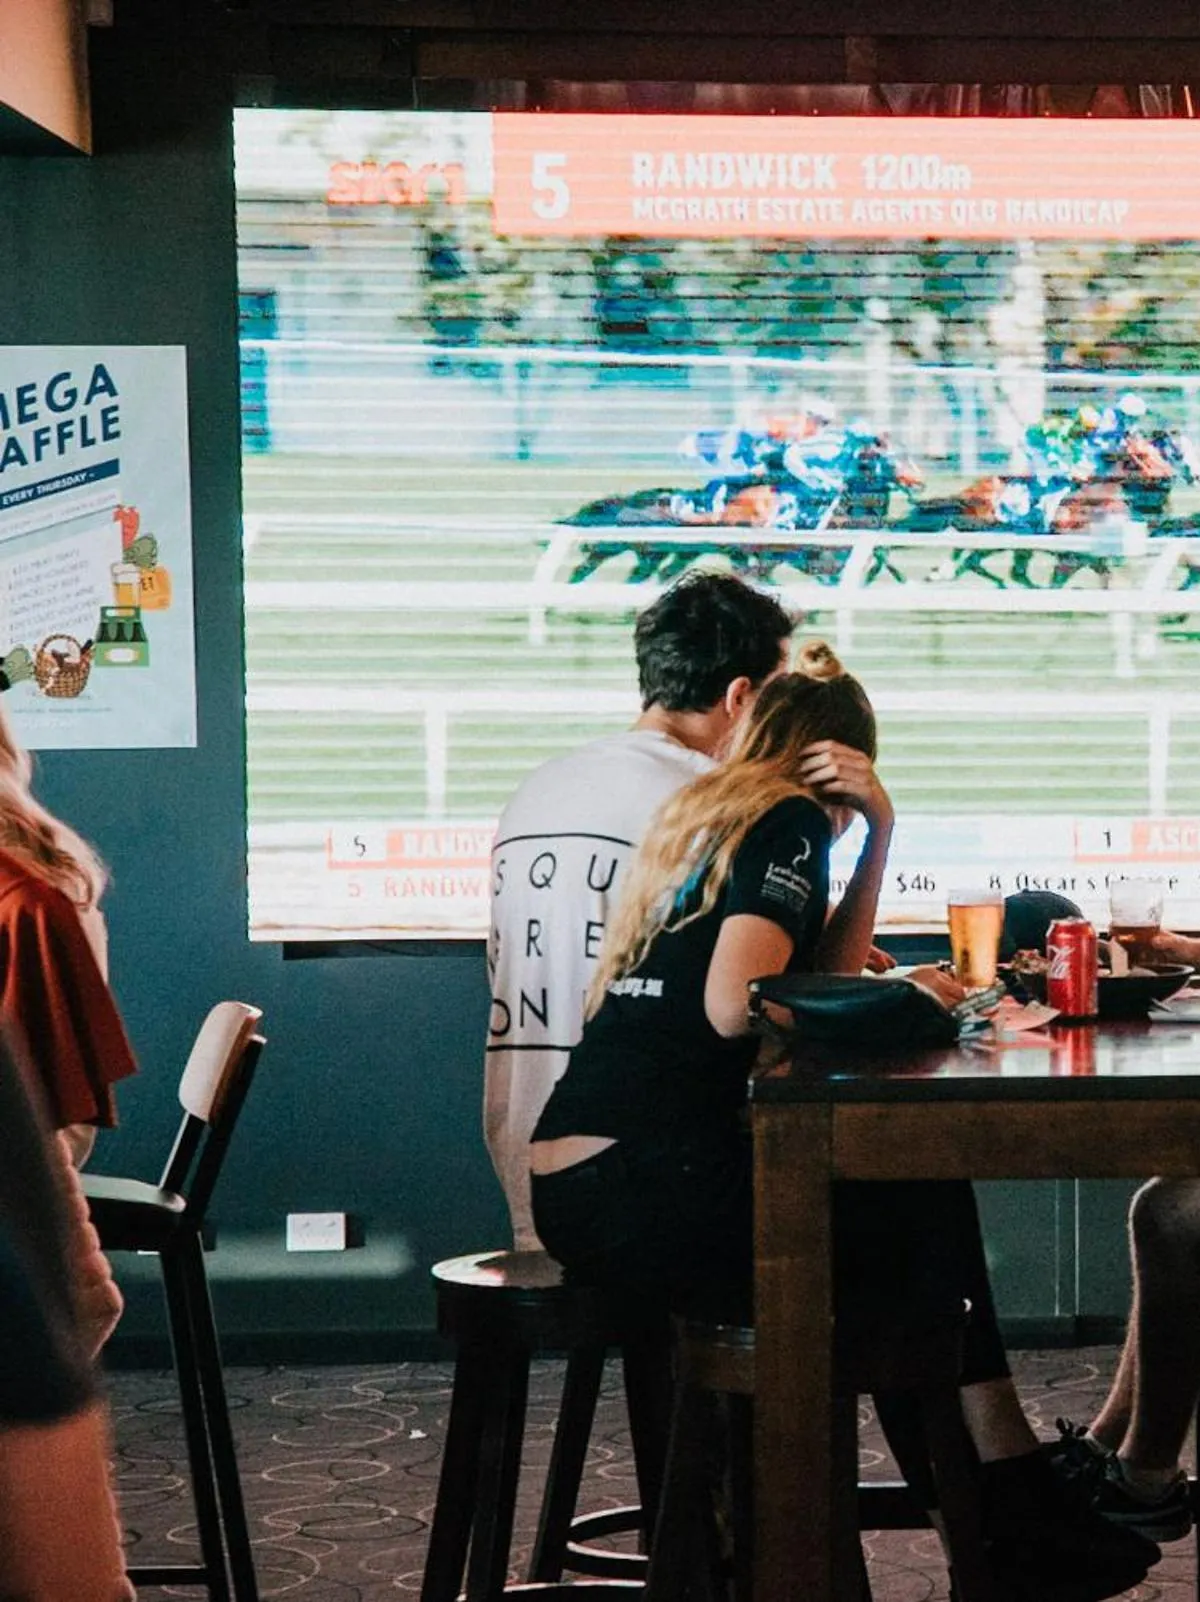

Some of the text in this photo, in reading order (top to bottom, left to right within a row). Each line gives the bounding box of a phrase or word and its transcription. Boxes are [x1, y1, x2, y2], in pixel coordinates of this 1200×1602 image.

[529, 153, 571, 220] 5
[632, 152, 972, 191] RANDWICK 1200m
[632, 197, 750, 222] MCGRATH
[757, 198, 844, 223] ESTATE
[852, 199, 943, 223] AGENTS
[3, 472, 88, 505] EVERY THURSDAY
[490, 987, 587, 1037] ON
